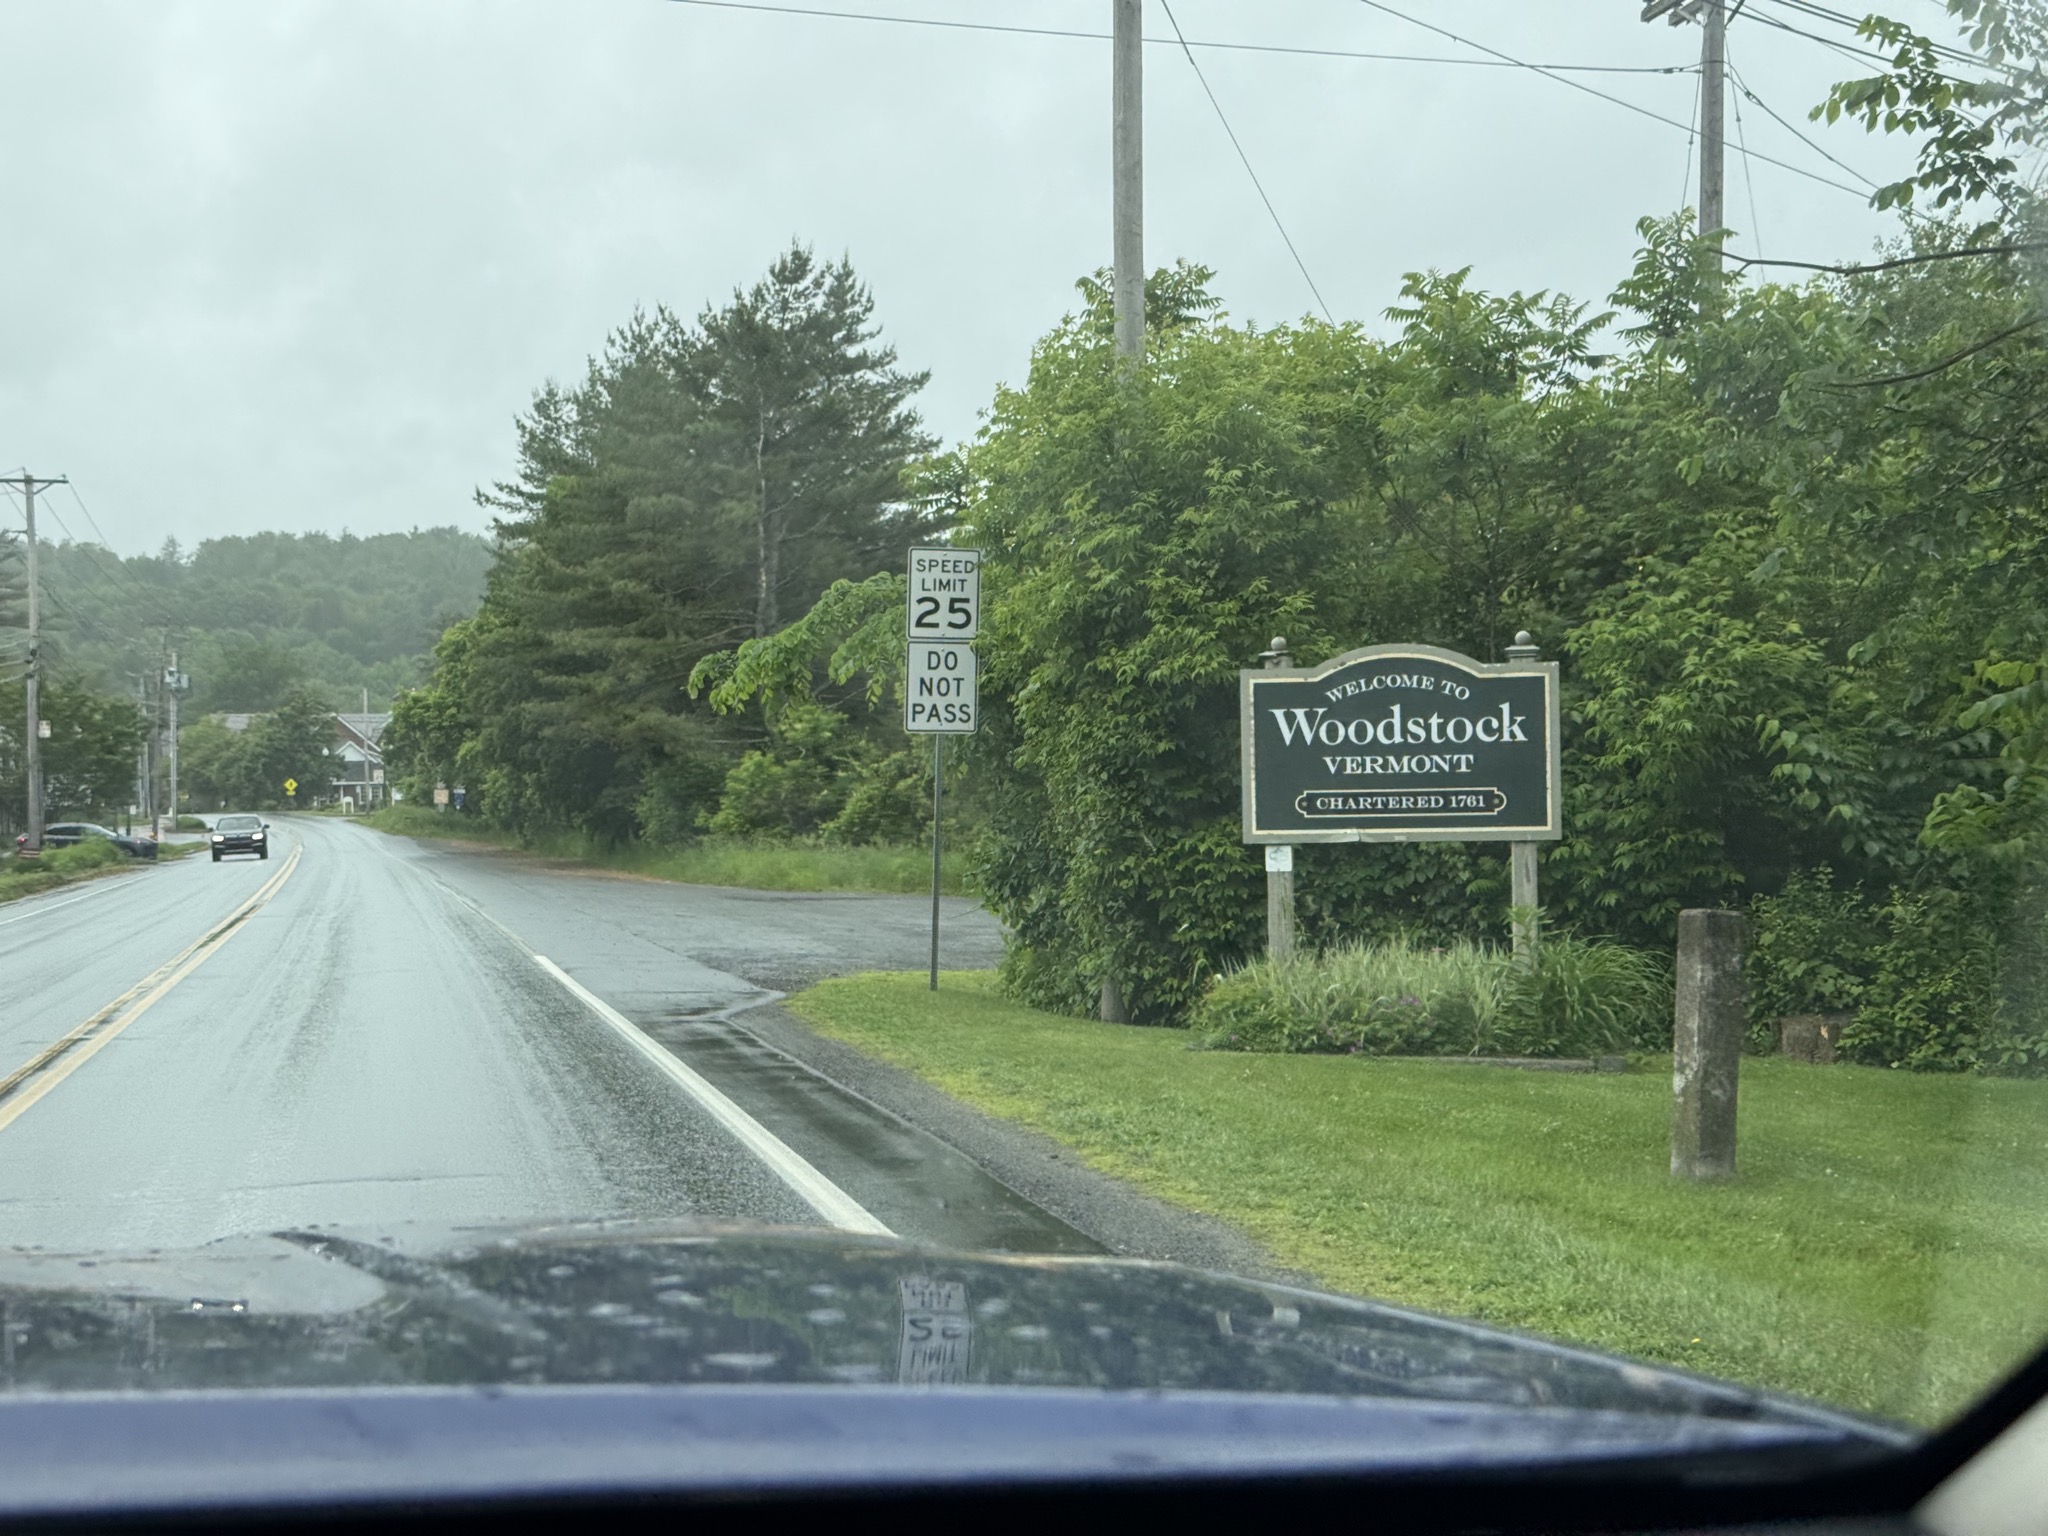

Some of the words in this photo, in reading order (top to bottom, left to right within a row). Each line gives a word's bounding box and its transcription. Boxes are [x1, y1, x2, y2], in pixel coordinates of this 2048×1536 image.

[916, 559, 975, 574] SPEED
[922, 578, 967, 592] LIMIT
[915, 597, 972, 630] 25
[927, 651, 958, 671] DO
[919, 677, 965, 697] NOT
[1325, 674, 1434, 703] WELCOME
[1440, 680, 1470, 701] TO
[912, 703, 971, 723] PASS
[1269, 702, 1528, 746] Woodstock
[1323, 754, 1474, 775] VERMONT
[1316, 795, 1445, 810] CHARTERED
[1449, 794, 1486, 809] 1761
